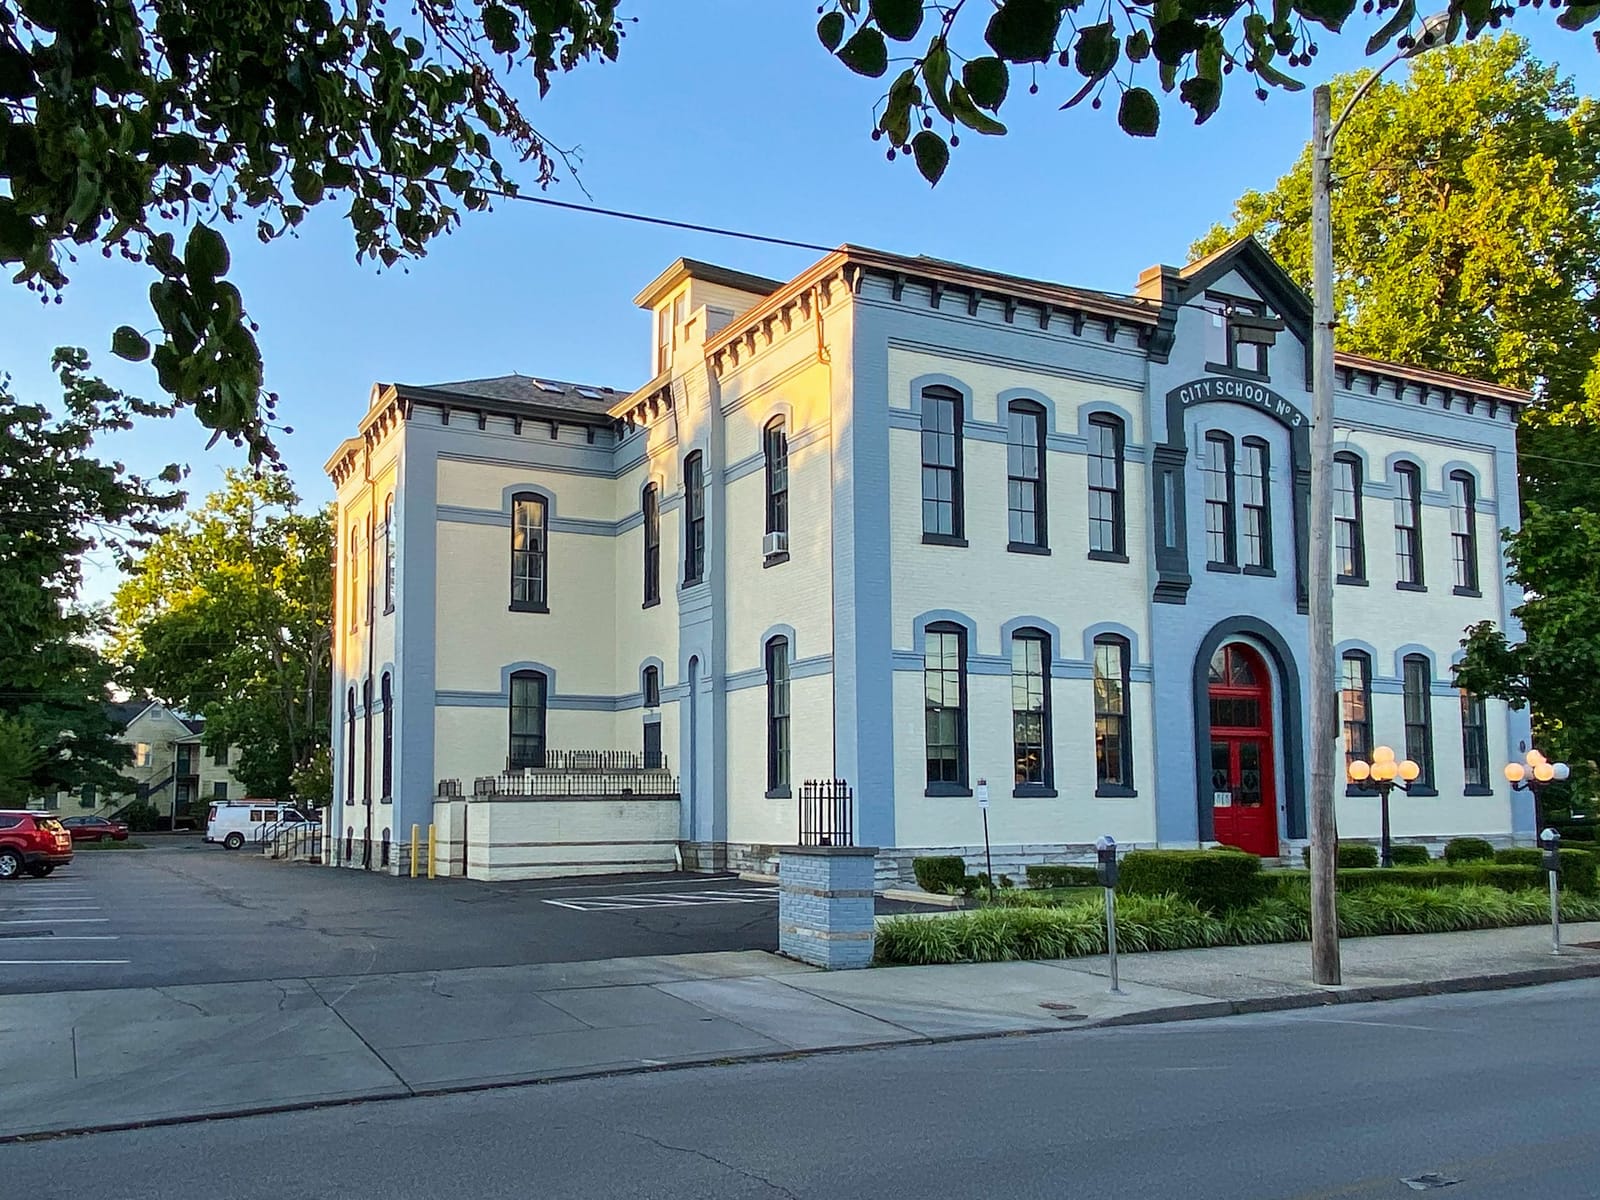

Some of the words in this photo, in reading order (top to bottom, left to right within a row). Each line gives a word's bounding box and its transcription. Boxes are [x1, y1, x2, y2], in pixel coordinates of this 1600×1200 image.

[1180, 382, 1210, 404] CITY
[1216, 381, 1271, 407] SCHOOL
[1292, 413, 1302, 426] 3
